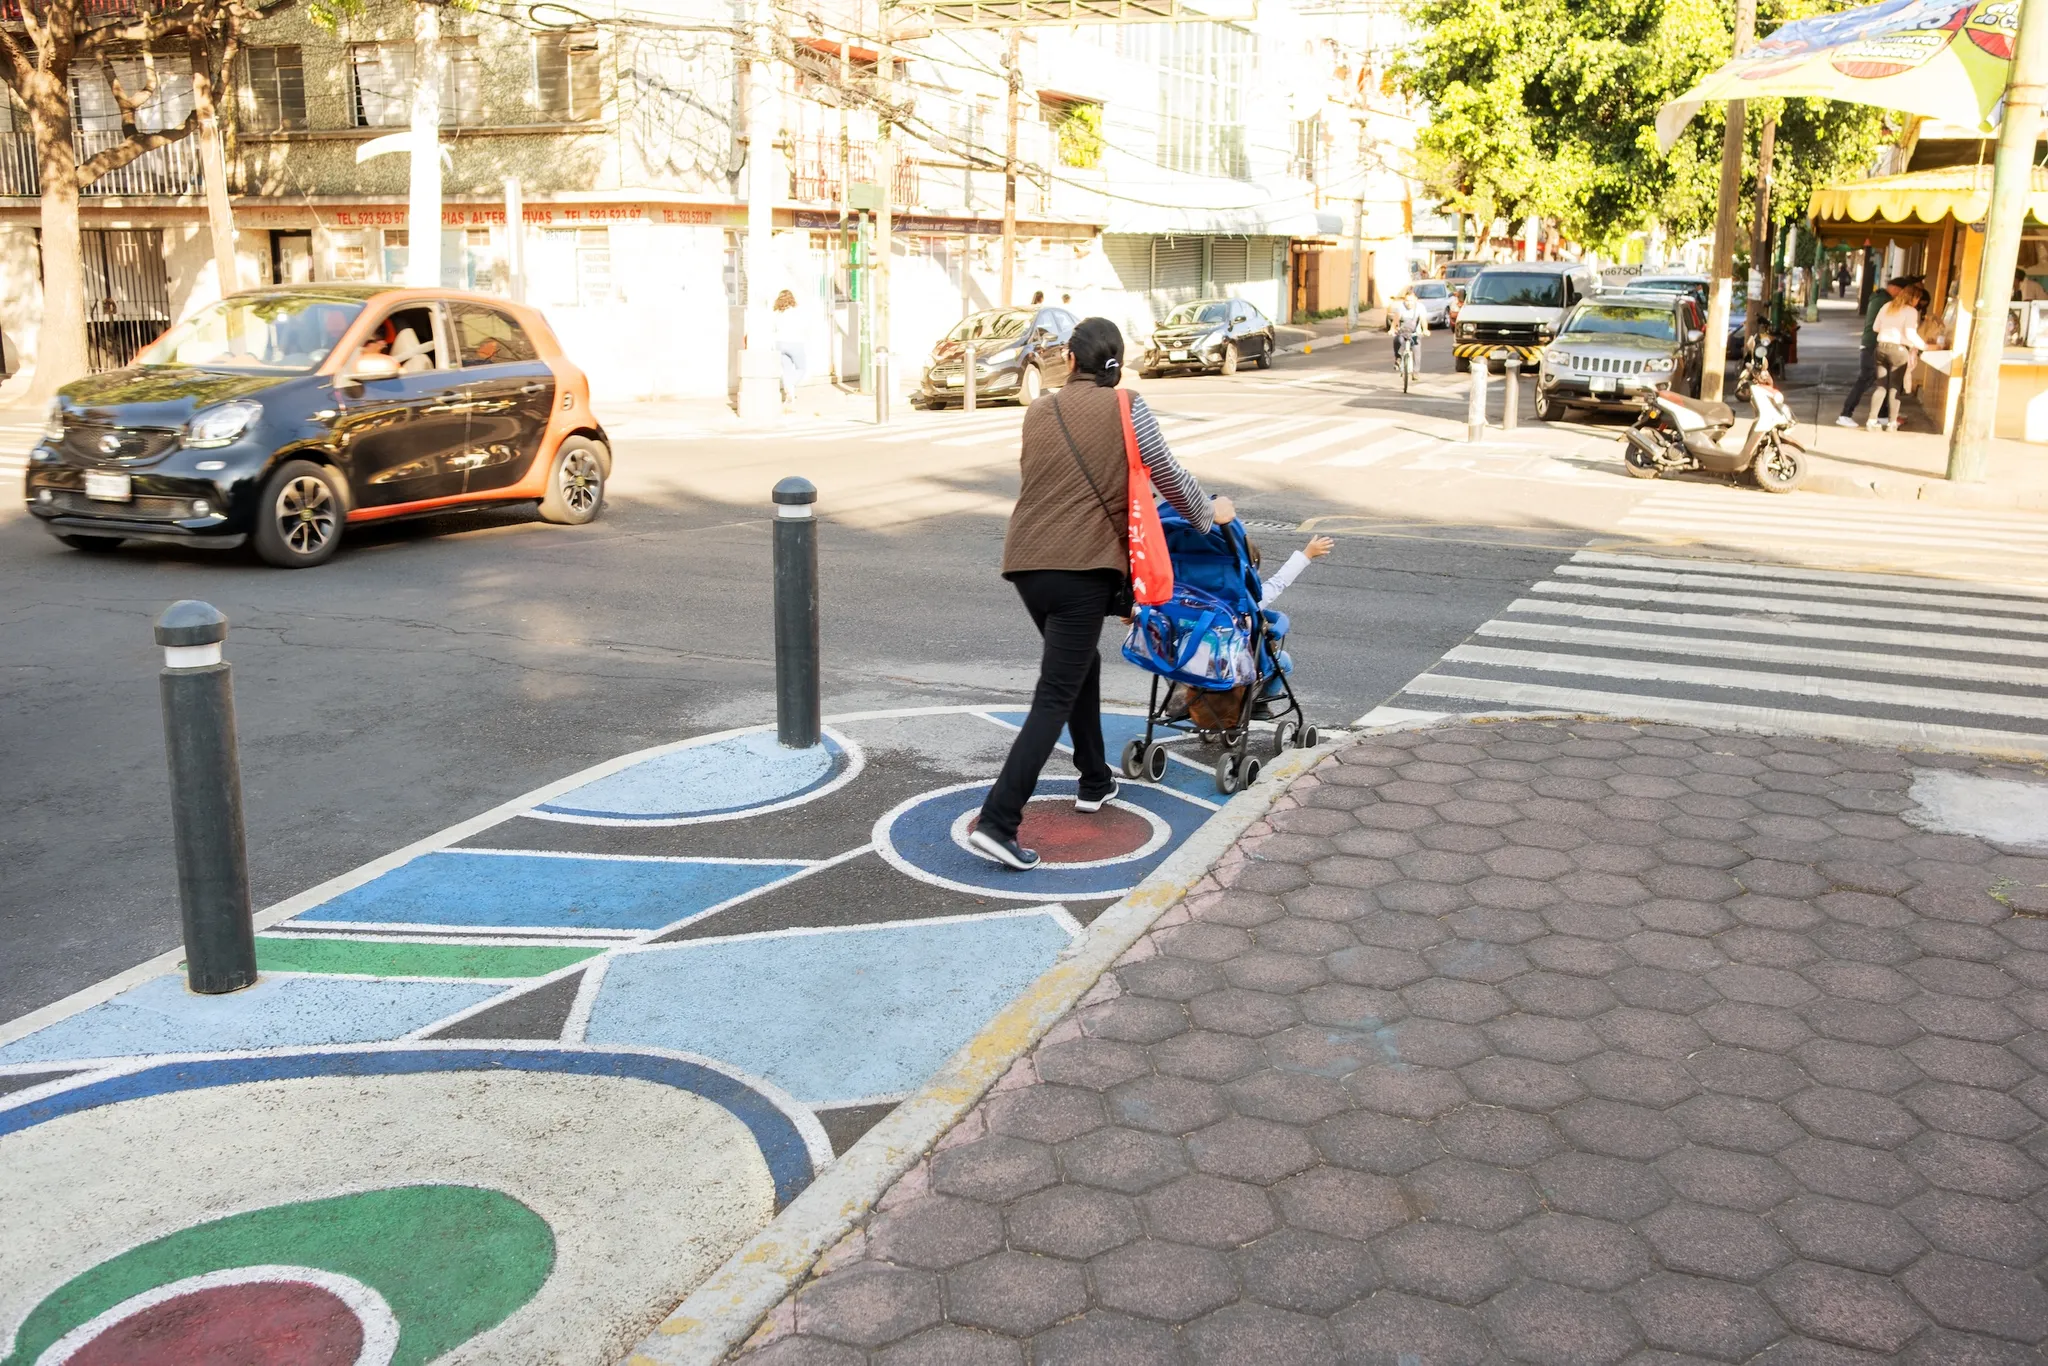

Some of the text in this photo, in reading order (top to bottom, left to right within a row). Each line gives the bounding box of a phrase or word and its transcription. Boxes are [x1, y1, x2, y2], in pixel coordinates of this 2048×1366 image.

[336, 211, 405, 225] TEL. 523 523 97
[588, 209, 606, 222] 523
[608, 208, 627, 222] 523
